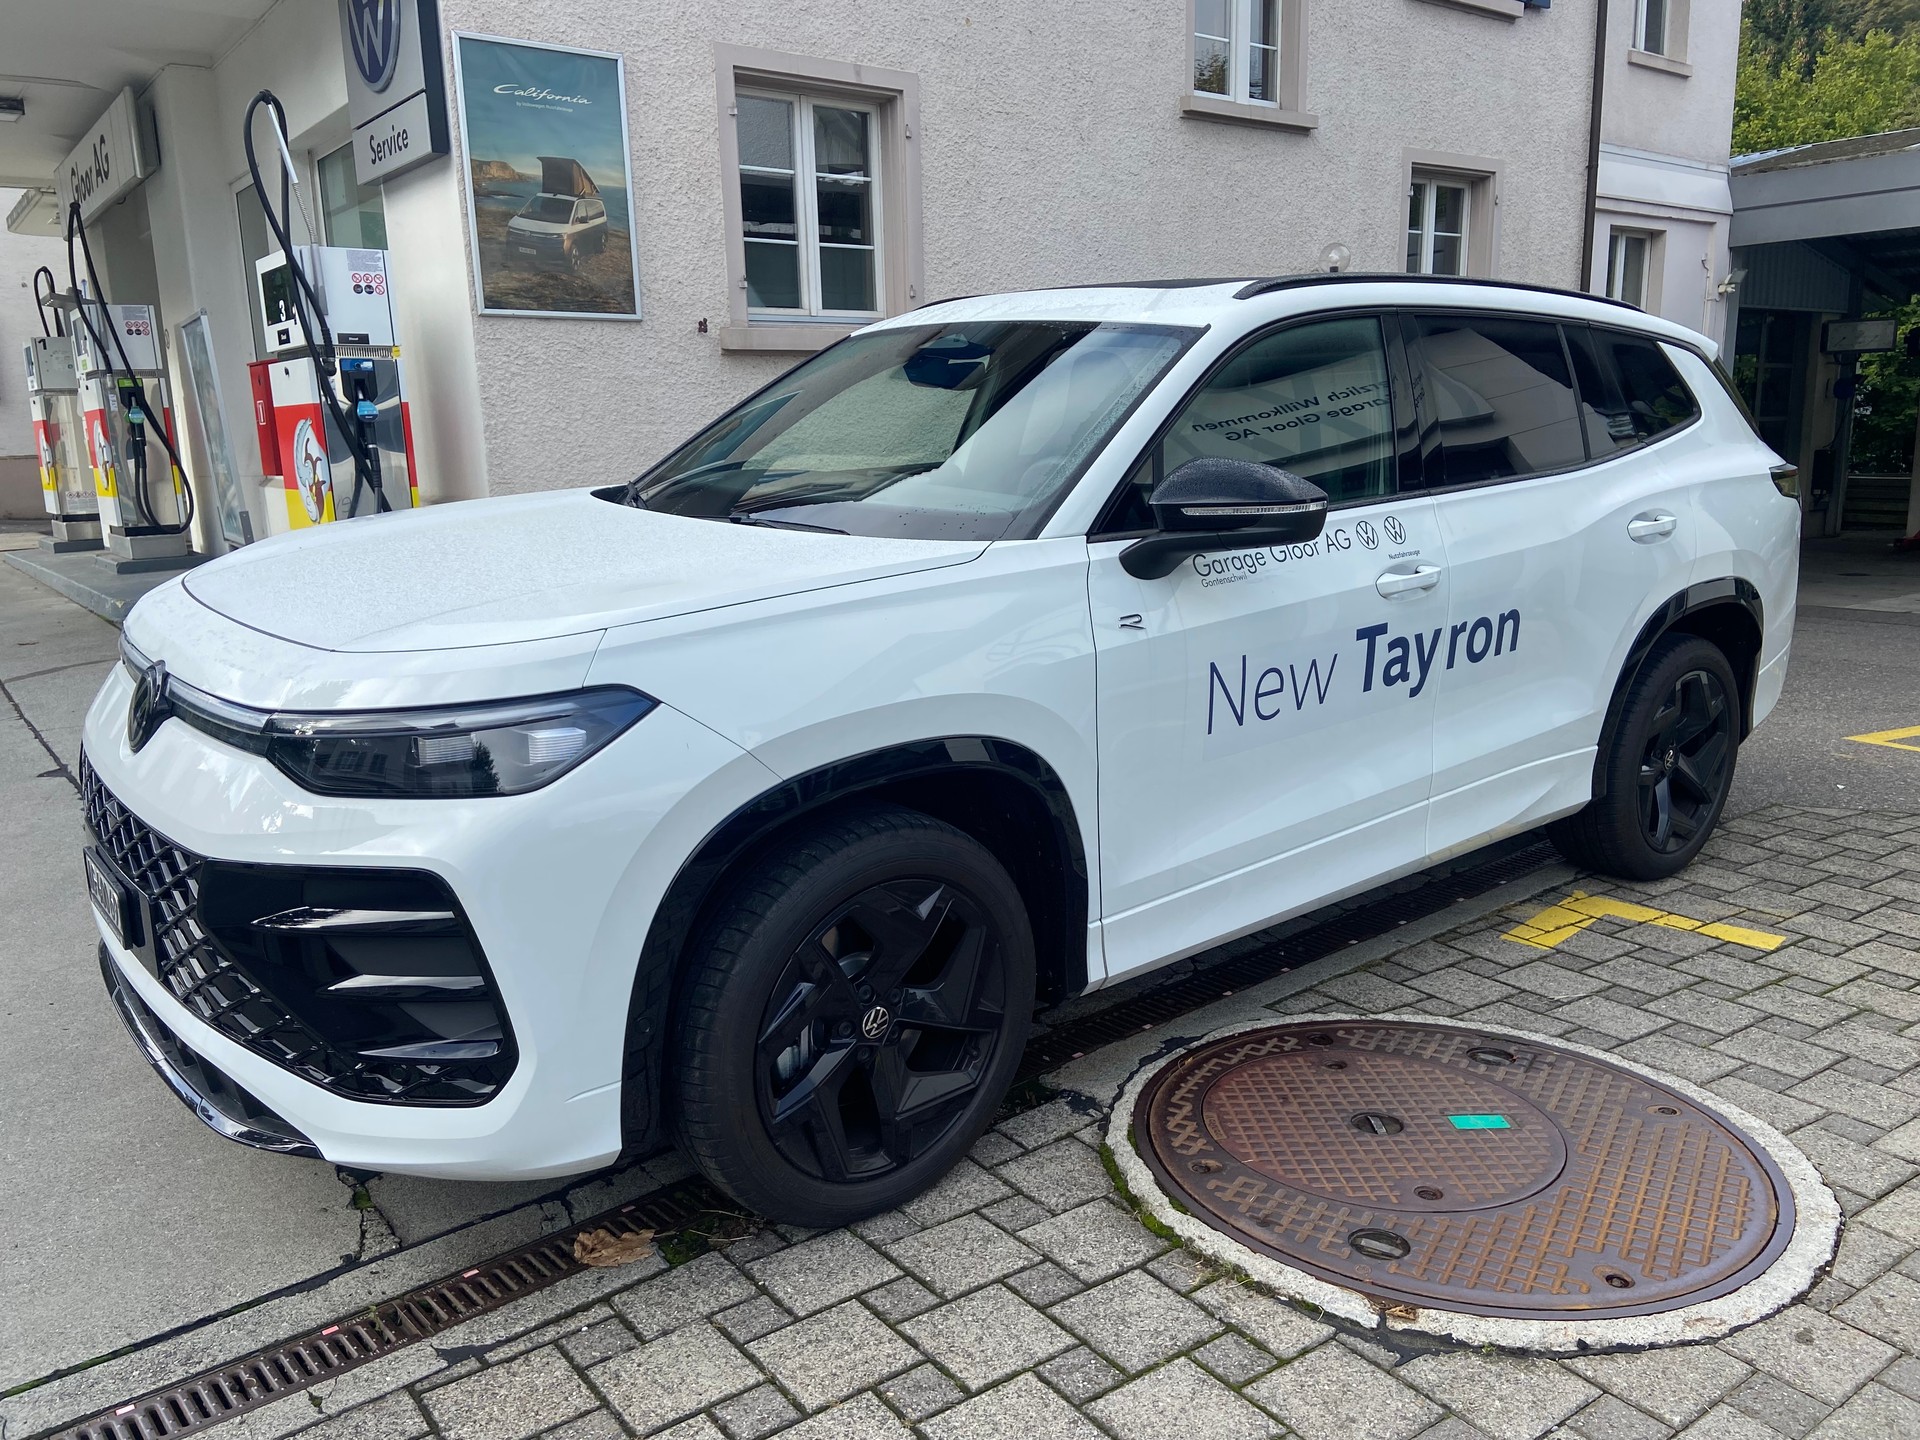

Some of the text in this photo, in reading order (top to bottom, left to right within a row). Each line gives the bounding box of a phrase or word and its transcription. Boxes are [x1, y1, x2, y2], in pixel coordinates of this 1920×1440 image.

[493, 84, 592, 104] California
[369, 124, 409, 165] Service
[70, 134, 110, 204] Gloor AG
[278, 300, 286, 321] 3
[1192, 551, 1267, 577] Garage
[1325, 528, 1352, 553] AG
[1201, 572, 1248, 588] Gontenschwil
[1206, 608, 1521, 735] New Tayron
